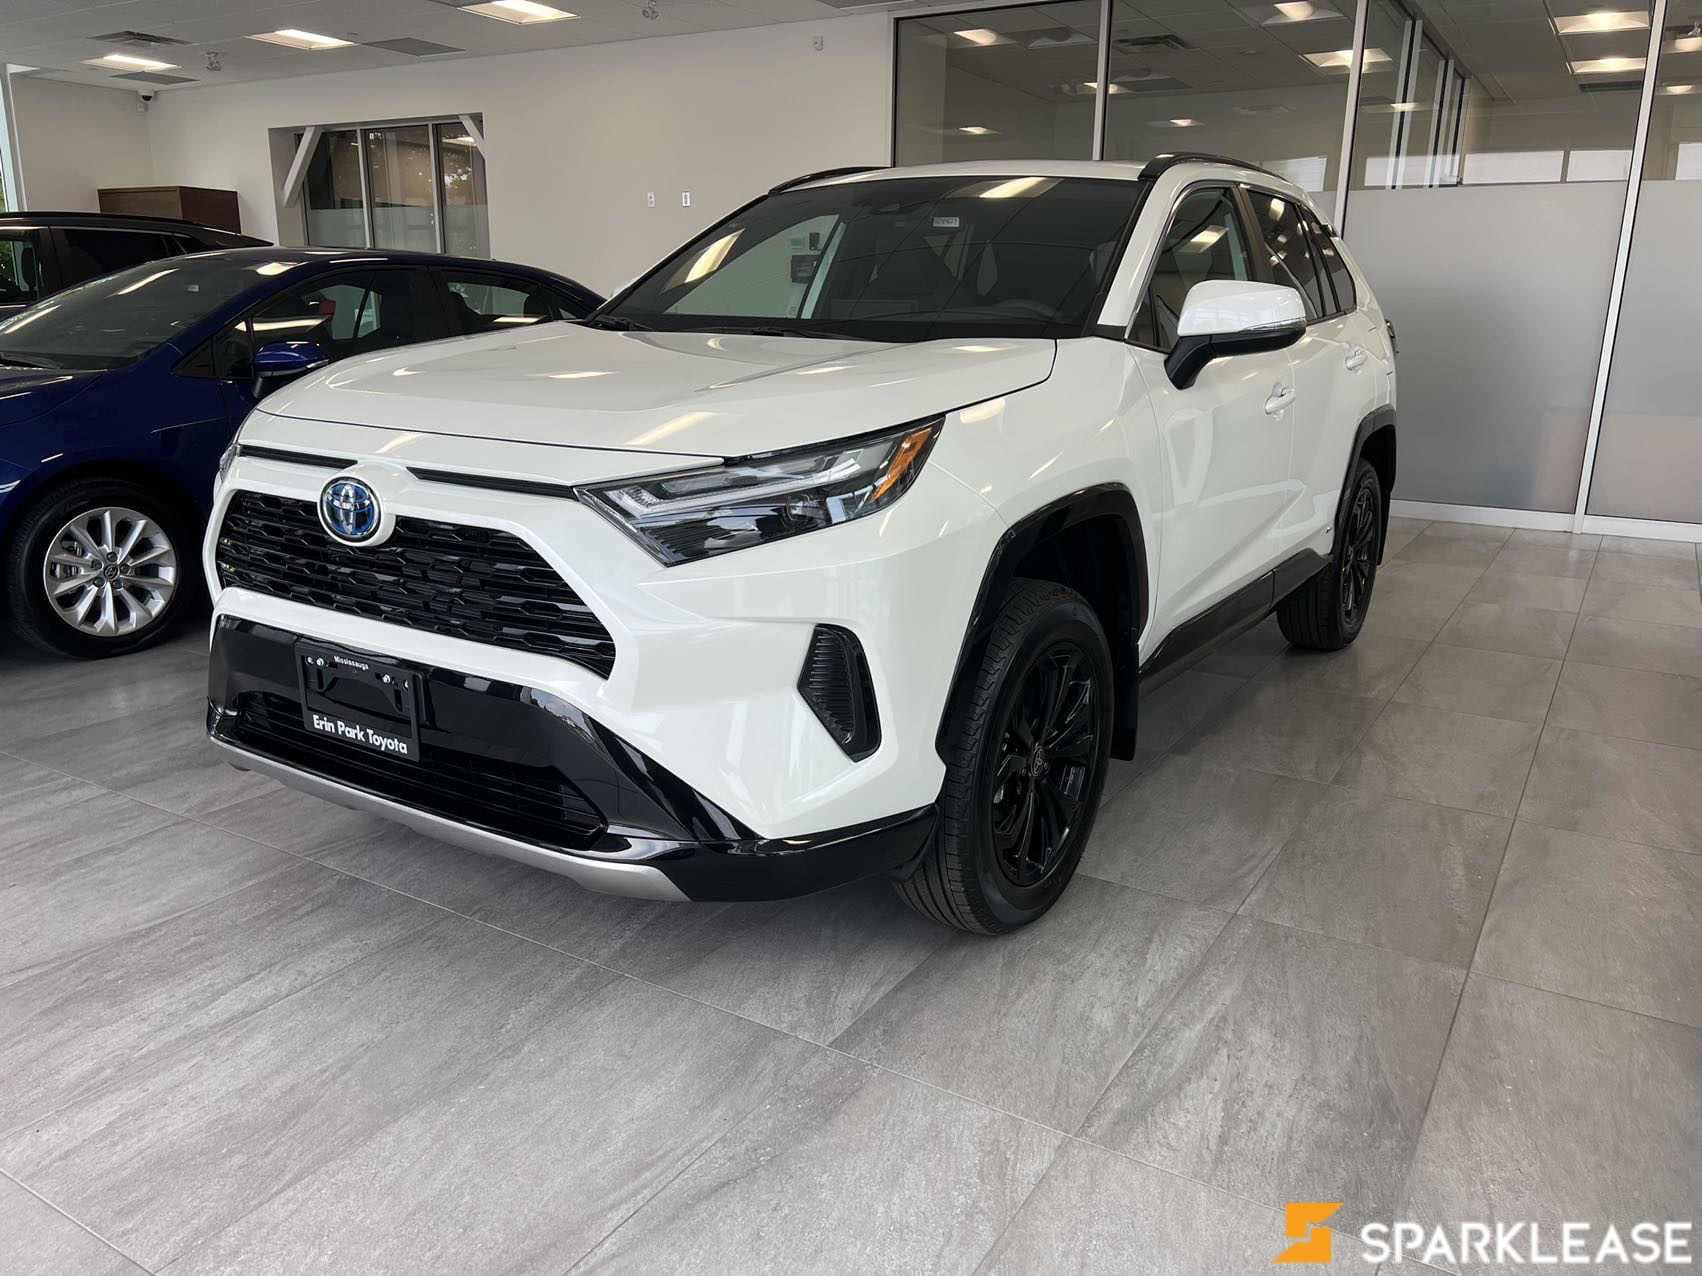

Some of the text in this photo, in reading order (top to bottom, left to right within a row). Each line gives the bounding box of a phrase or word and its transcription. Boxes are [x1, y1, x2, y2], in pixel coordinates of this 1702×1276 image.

[333, 655, 369, 671] Mississauga
[312, 714, 408, 754] Erin Park Toyota
